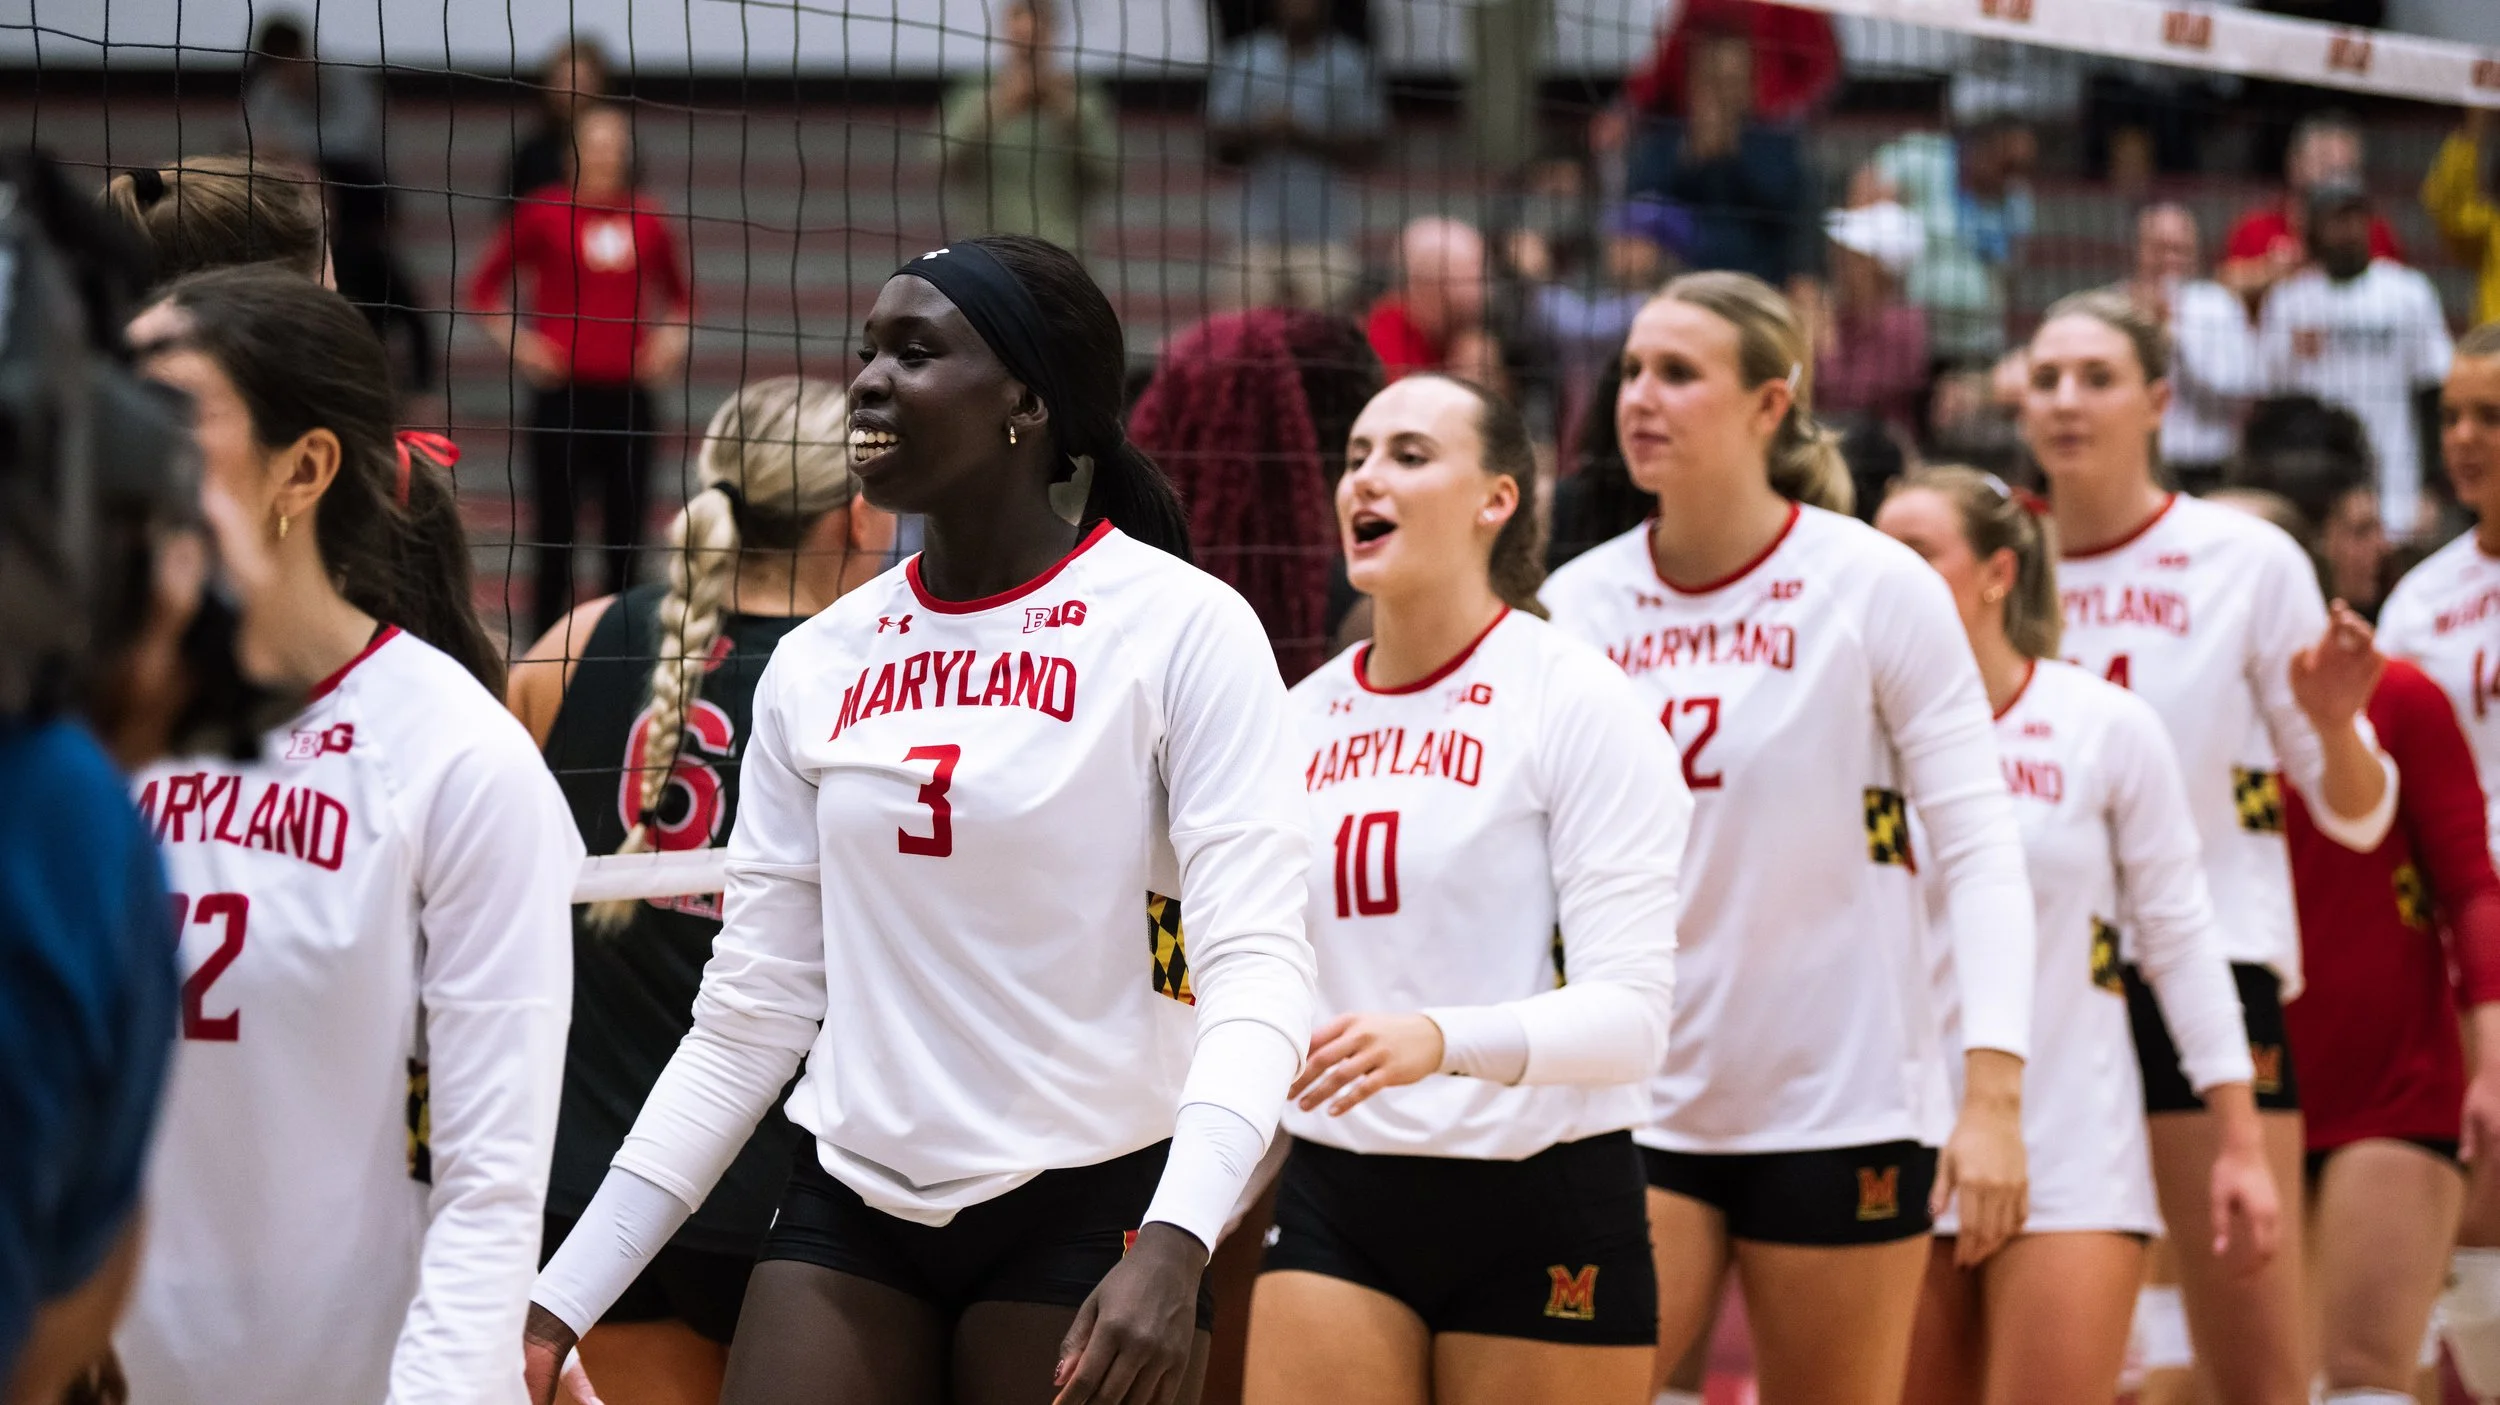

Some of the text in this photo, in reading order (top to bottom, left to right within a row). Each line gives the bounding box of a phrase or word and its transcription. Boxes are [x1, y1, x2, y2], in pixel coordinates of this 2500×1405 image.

[828, 650, 1077, 743] MARYLAND
[138, 772, 349, 871] ARYLAND
[617, 698, 736, 853] 6
[898, 743, 961, 858] 3
[1334, 811, 1400, 919] 10
[165, 892, 249, 1041] 2
[1544, 1264, 1600, 1320] M
